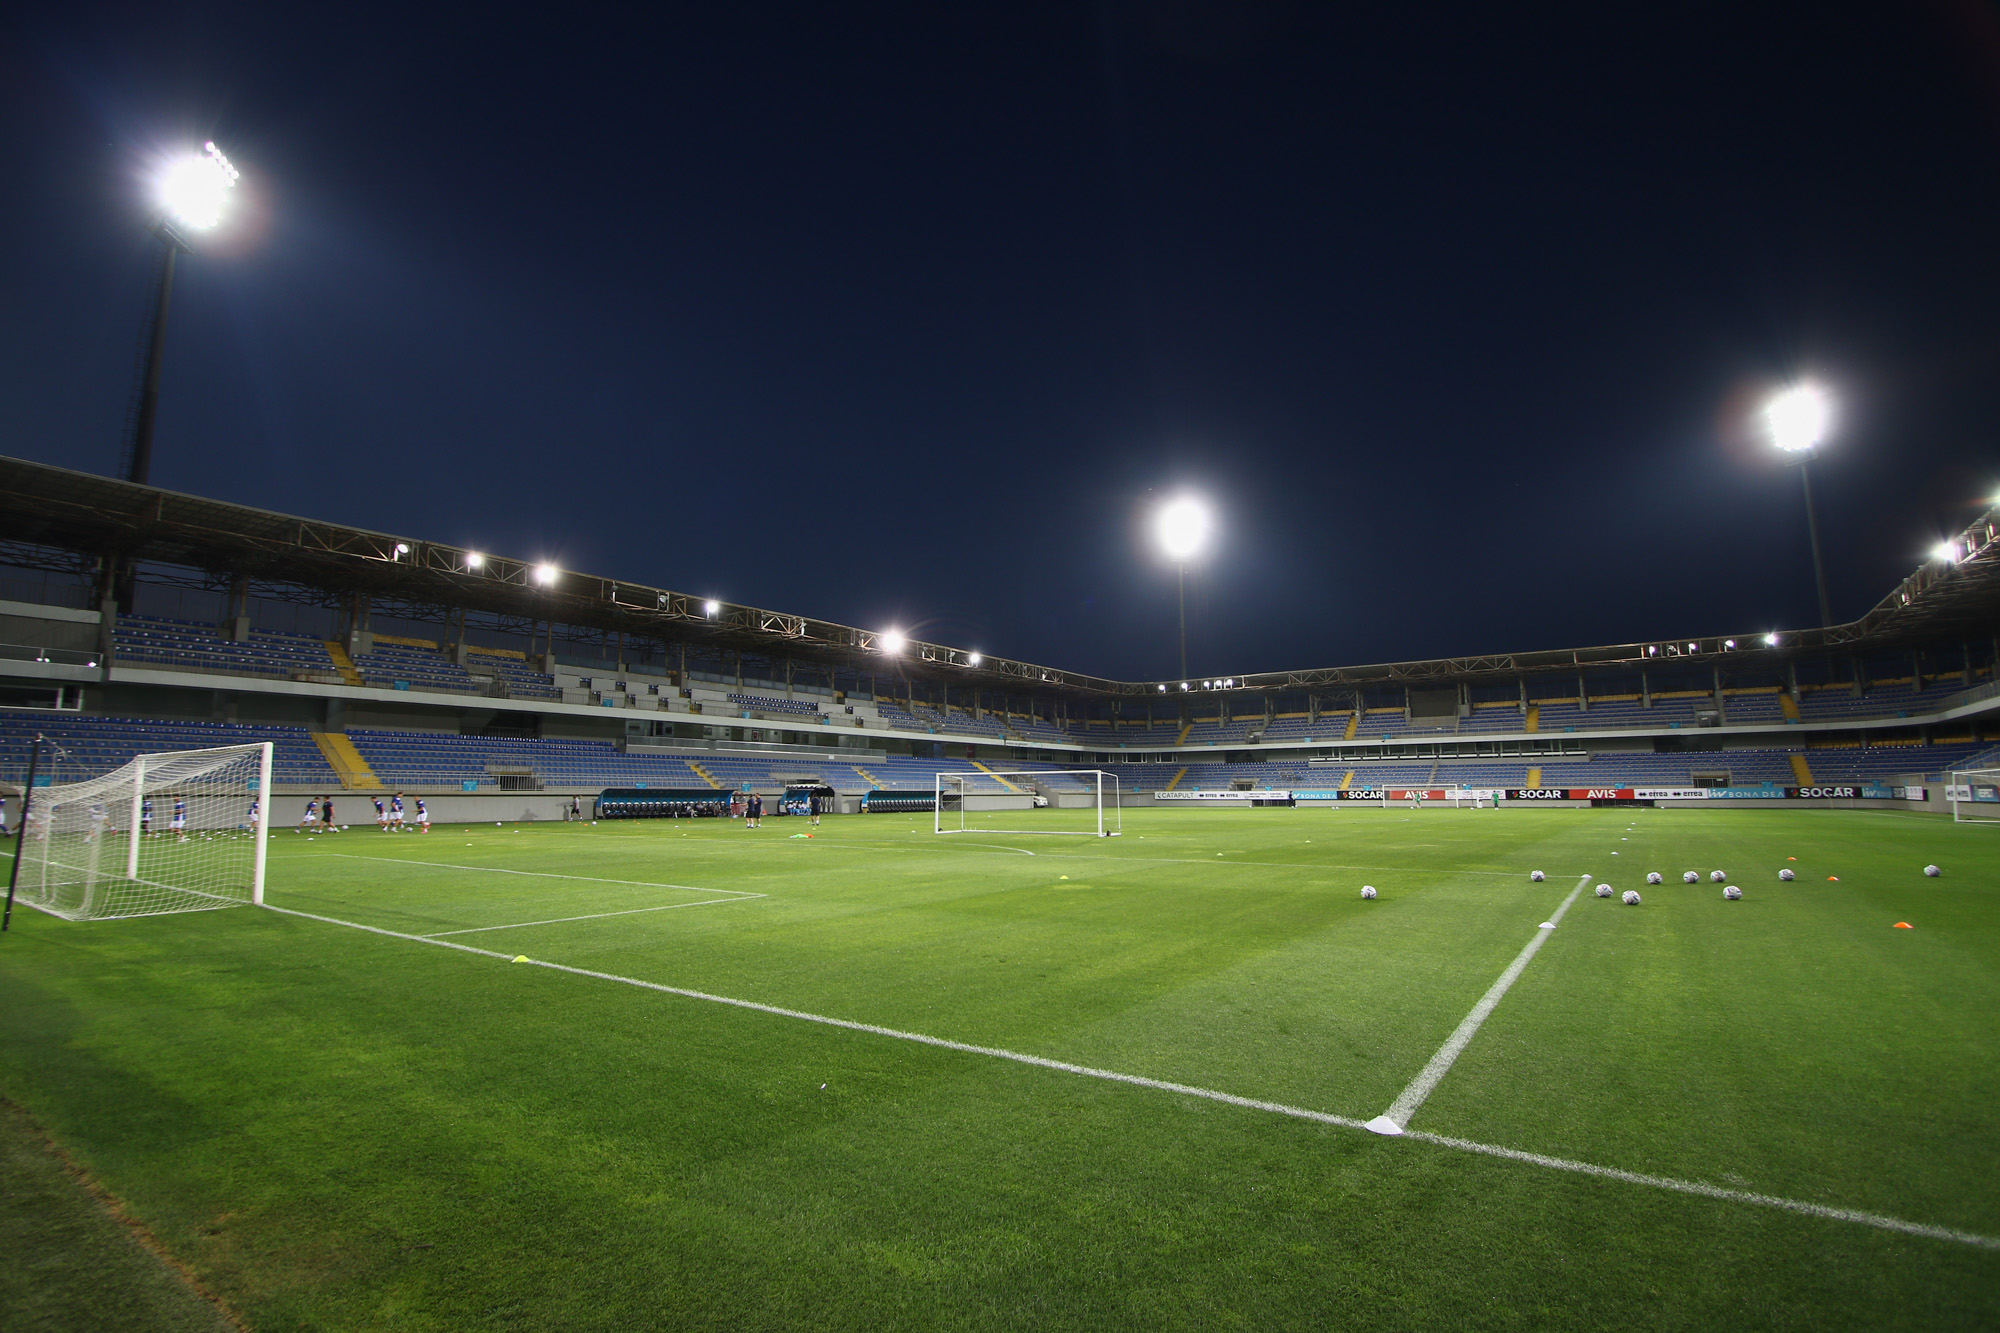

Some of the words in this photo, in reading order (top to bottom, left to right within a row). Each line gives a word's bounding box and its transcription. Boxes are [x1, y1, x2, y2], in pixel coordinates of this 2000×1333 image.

[1348, 791, 1383, 799] SOCAR
[1519, 790, 1561, 799] SOCAR
[1587, 789, 1616, 798] AVIS
[1799, 787, 1854, 798] SOCAR
